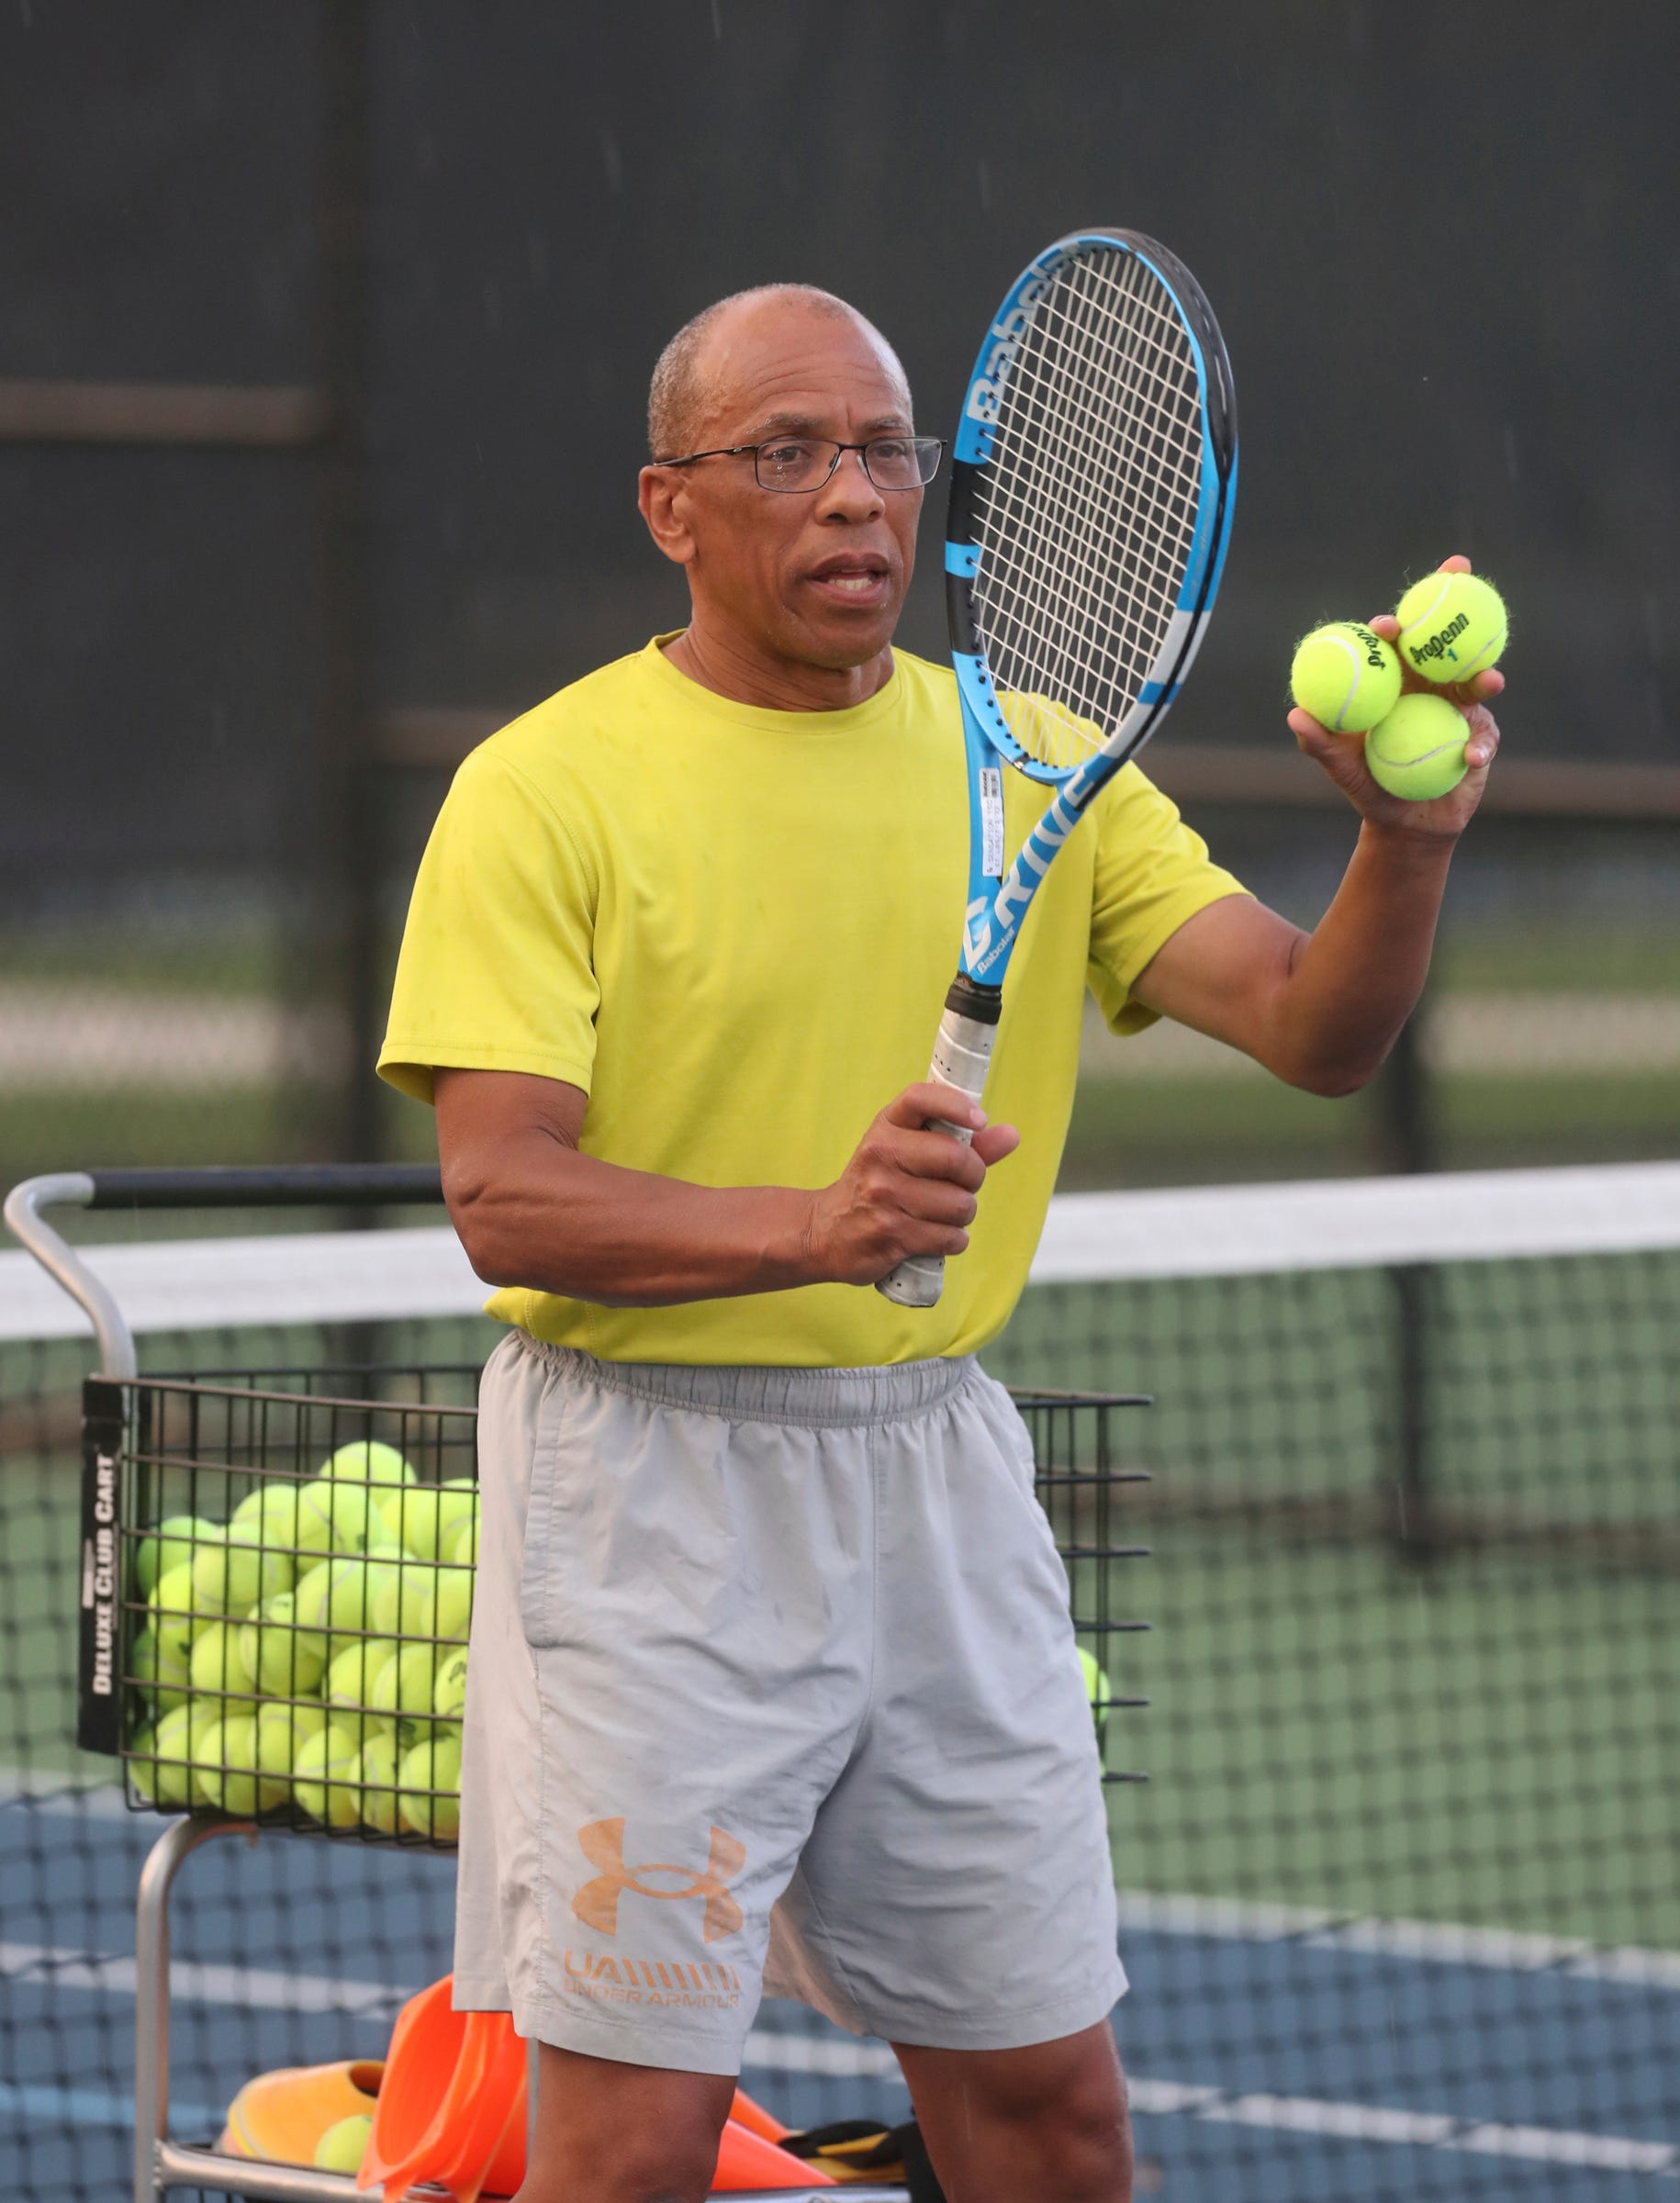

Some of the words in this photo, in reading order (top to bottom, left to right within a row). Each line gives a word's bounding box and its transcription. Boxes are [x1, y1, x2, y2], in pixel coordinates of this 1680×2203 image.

[1448, 647, 1459, 662] 1
[977, 923, 1016, 975] Babolat
[95, 1452, 114, 1523] CART
[95, 1527, 113, 1597] CLUB
[93, 1600, 112, 1695] DELUXE
[563, 1975, 641, 2006] UNDER
[645, 1991, 740, 2009] ARMOUR
